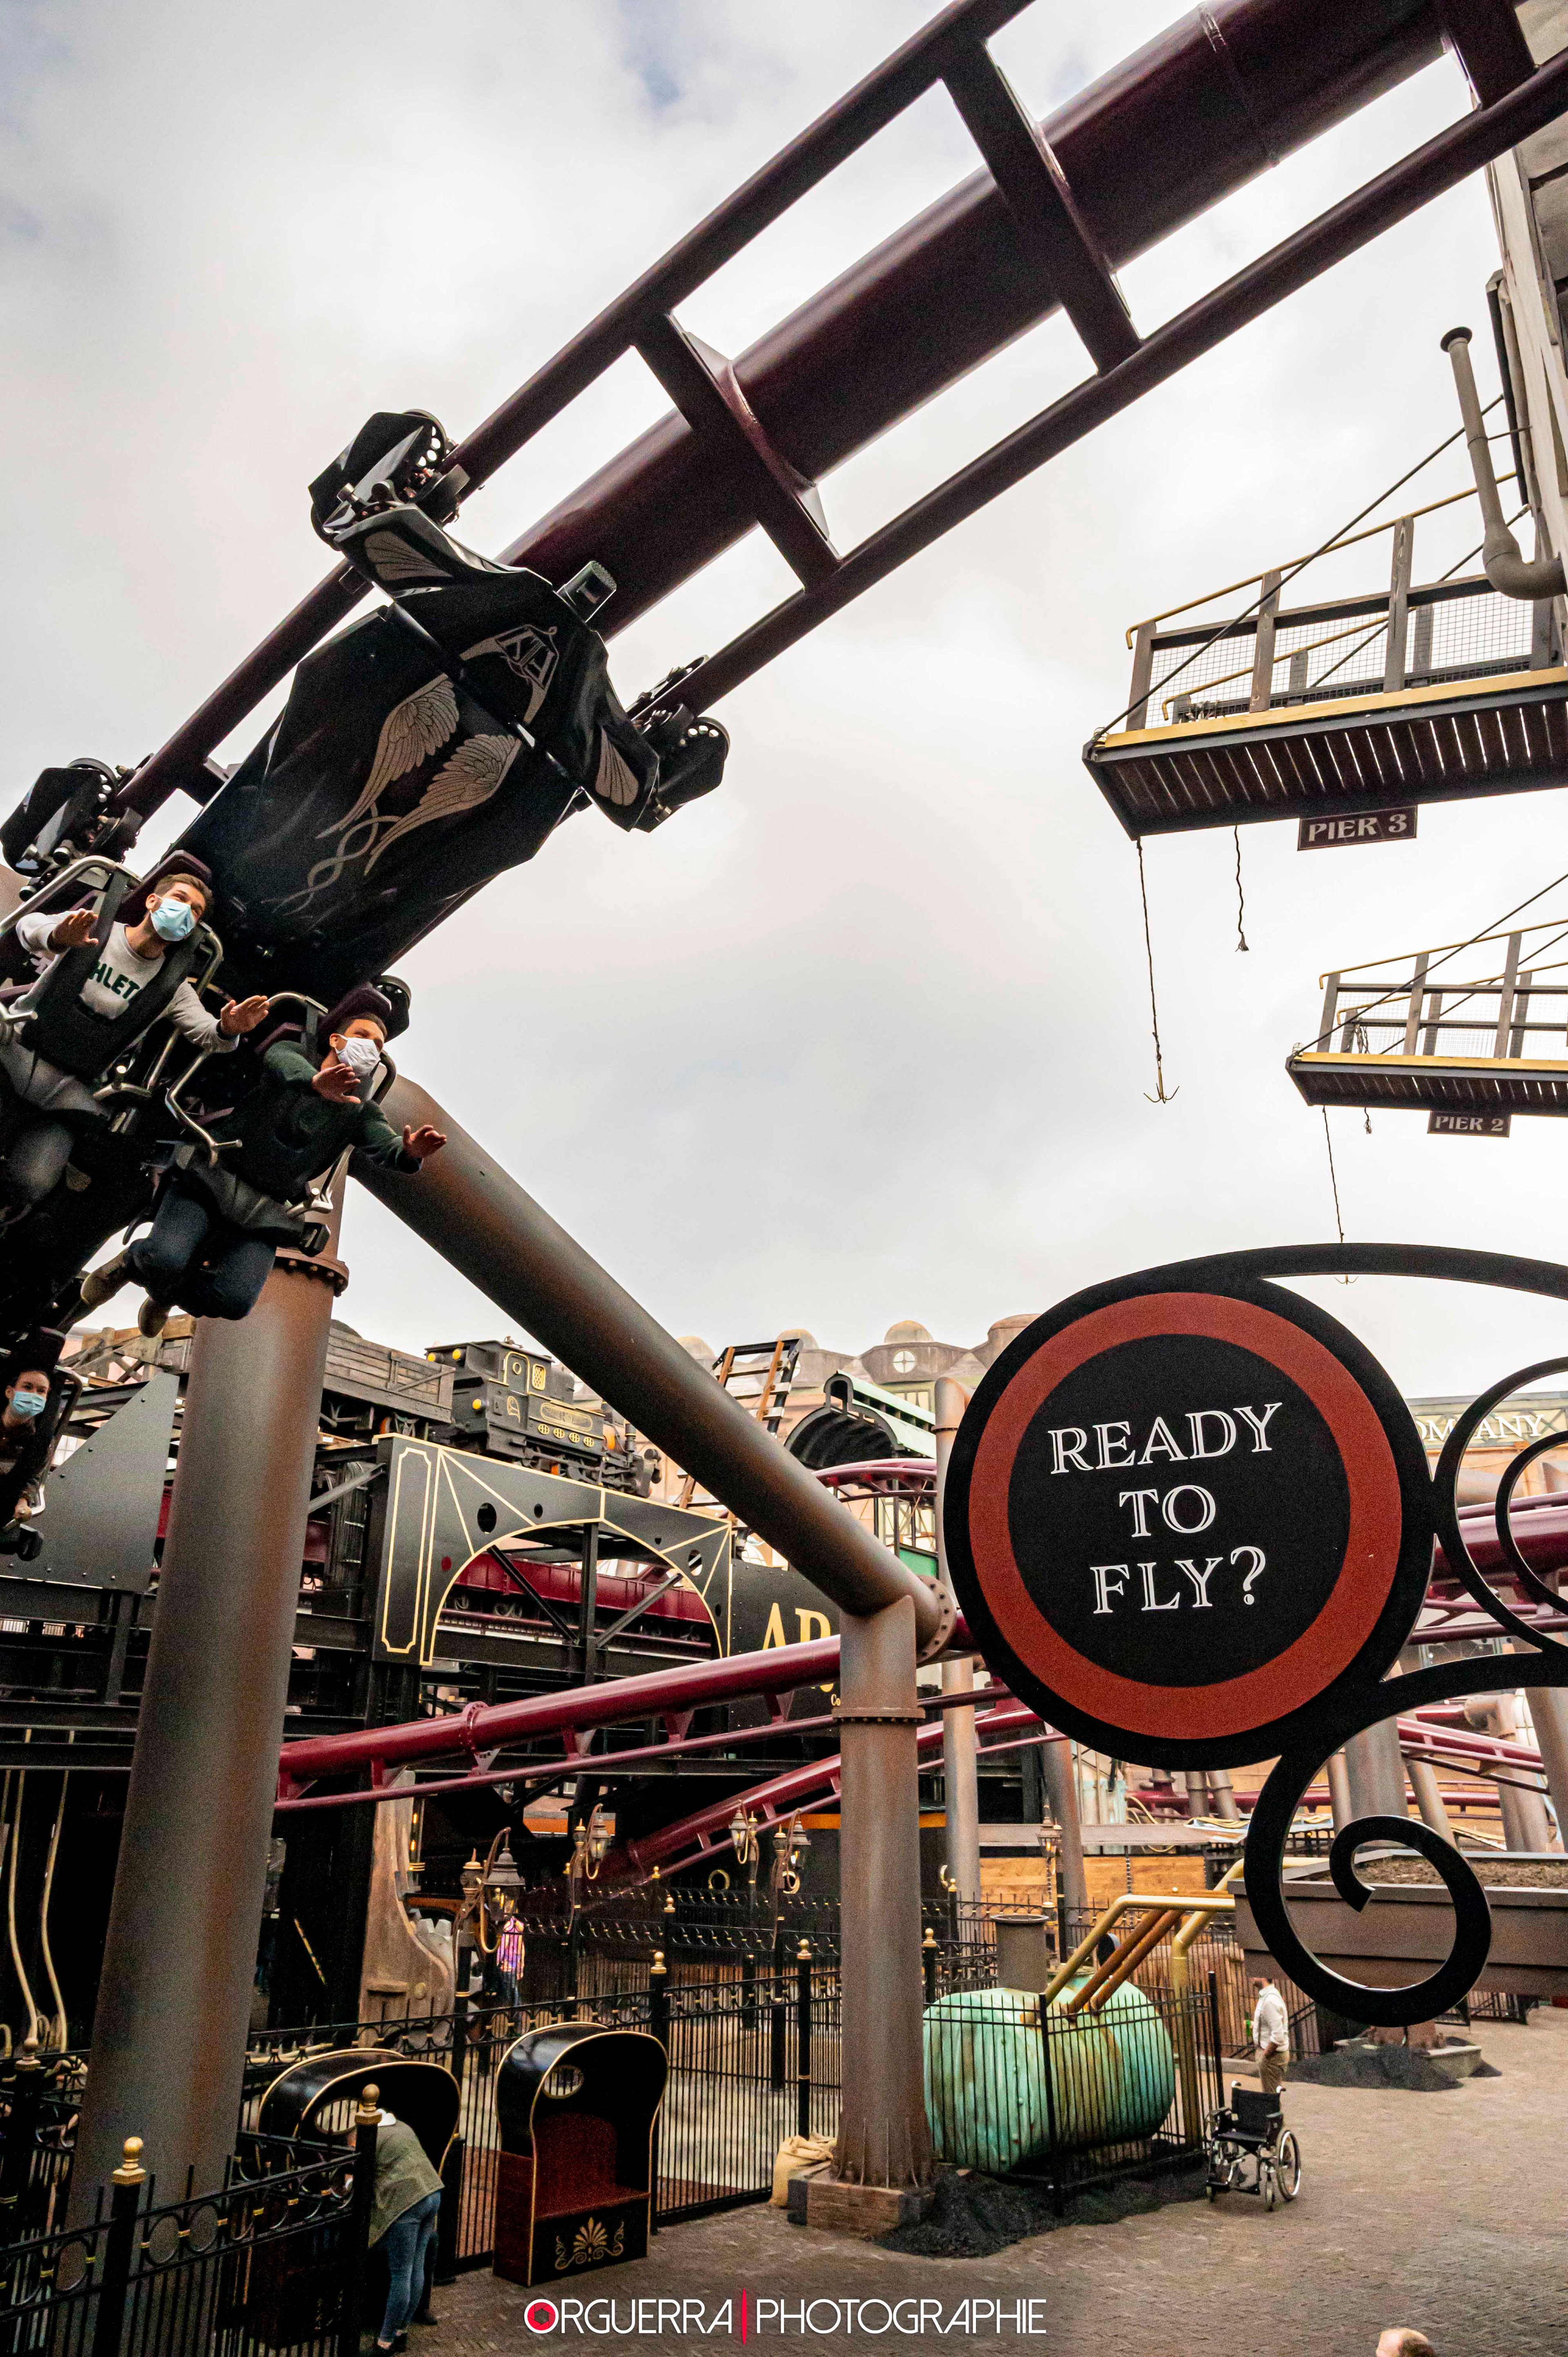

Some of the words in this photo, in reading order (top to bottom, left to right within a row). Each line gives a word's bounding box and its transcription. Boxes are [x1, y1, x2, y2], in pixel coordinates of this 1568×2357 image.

[1308, 817, 1378, 842] PIER
[1388, 814, 1407, 833] 3
[1435, 1116, 1483, 1131] PIER
[1491, 1118, 1504, 1131] 2
[1047, 1402, 1283, 1474] READY
[1119, 1485, 1216, 1537] TO
[1090, 1546, 1266, 1614] FLY?
